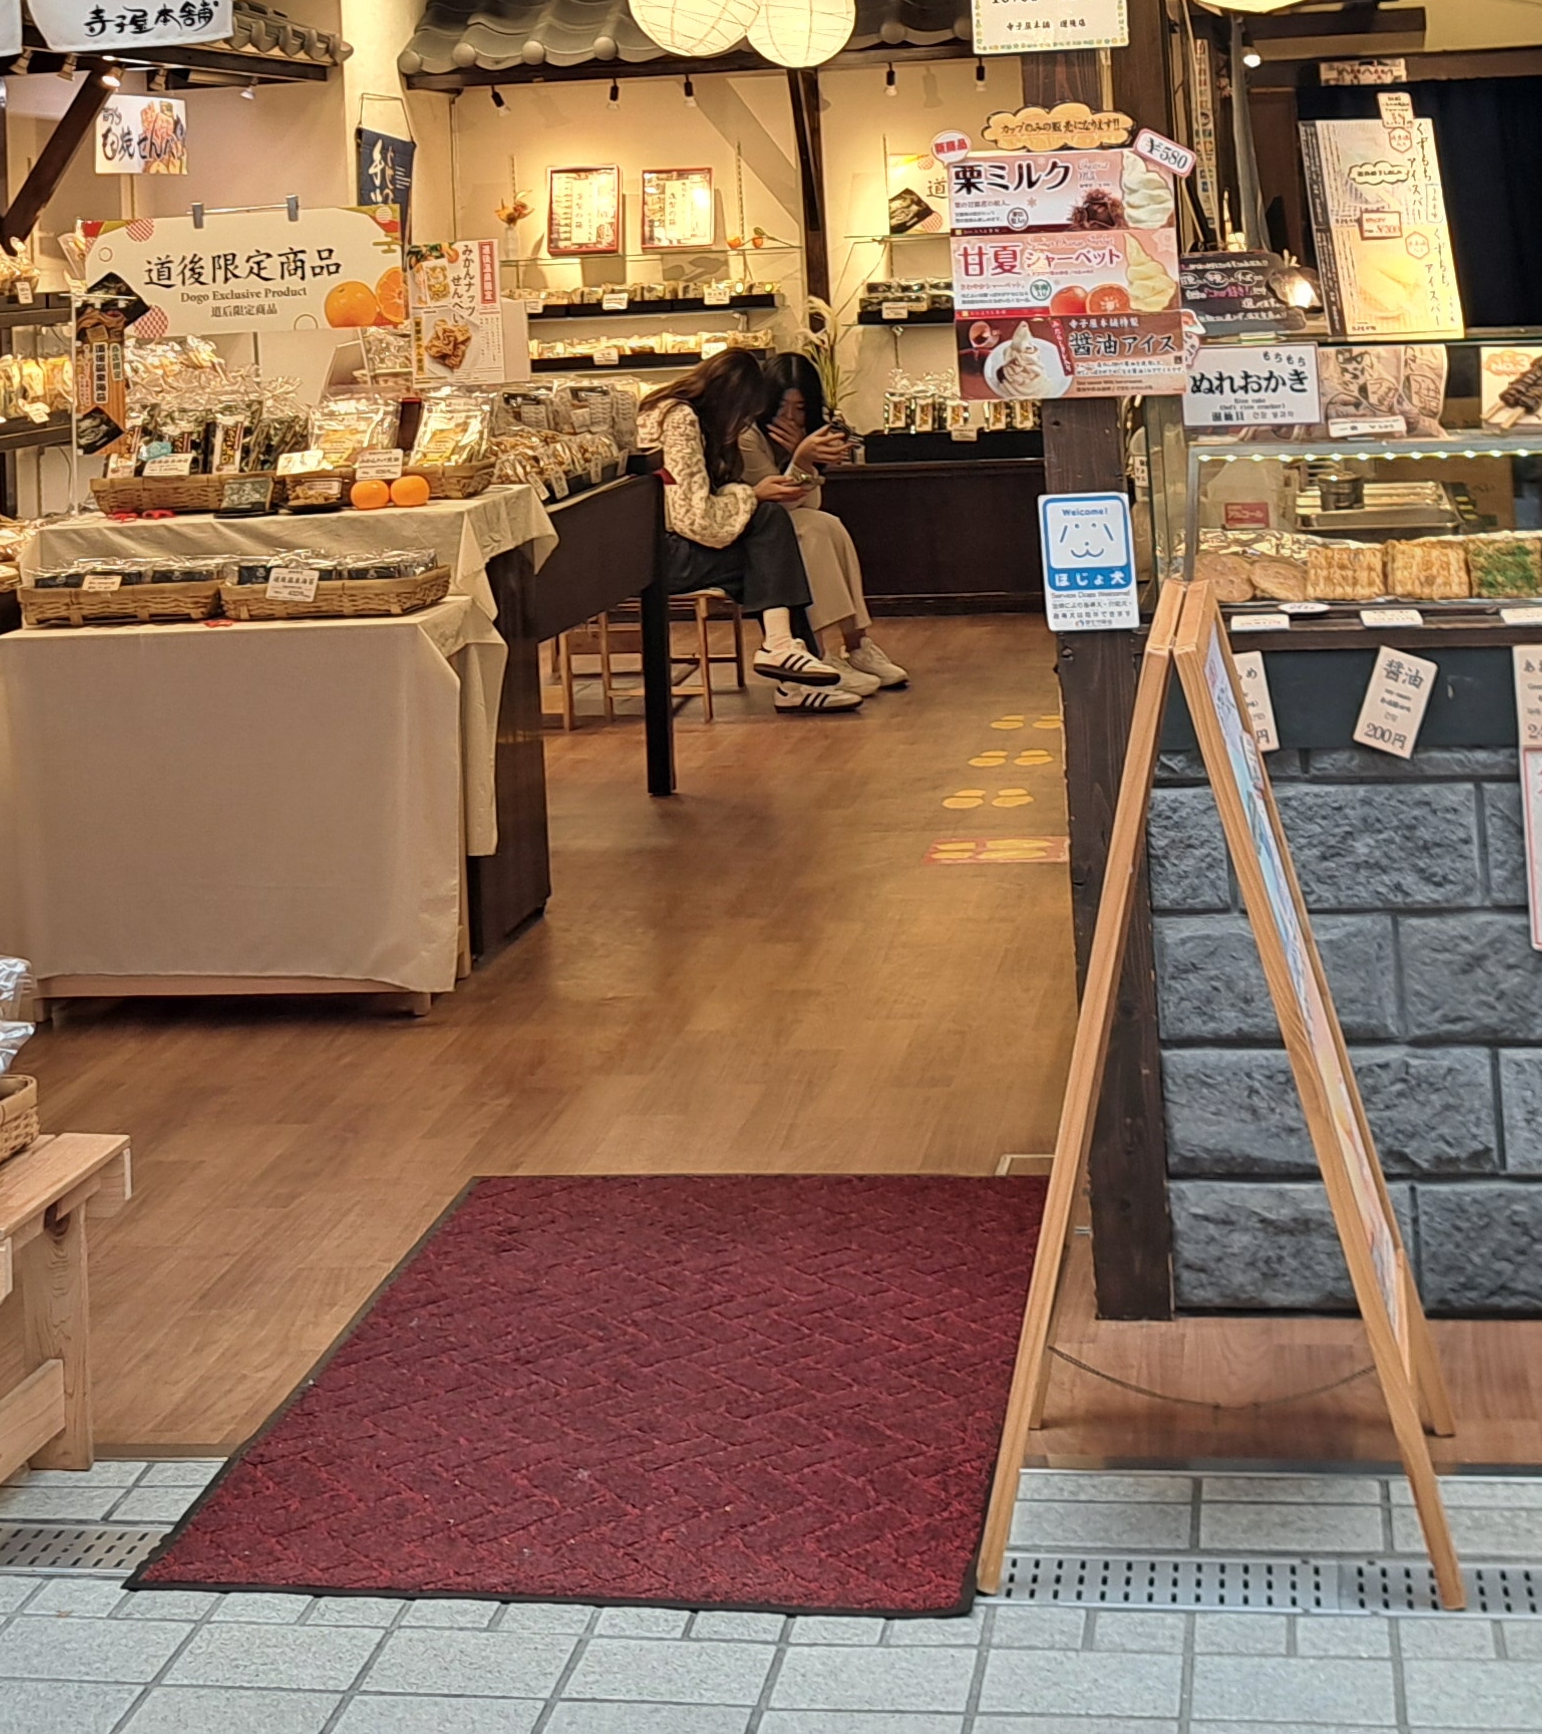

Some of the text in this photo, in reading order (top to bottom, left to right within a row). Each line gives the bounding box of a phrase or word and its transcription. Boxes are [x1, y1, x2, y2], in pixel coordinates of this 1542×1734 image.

[1146, 137, 1188, 169] ¥580
[953, 161, 1071, 195] 栗ミルク
[143, 247, 342, 290] 道後限定商品
[958, 246, 1121, 277] 甘夏 シャーベット
[180, 286, 307, 304] Dogo Exclusive Product
[461, 245, 476, 317] みかんナッツ
[450, 275, 465, 324] せんべい
[1068, 332, 1177, 356] 醤油アイス
[1263, 351, 1306, 366] もちもち
[1190, 369, 1309, 395] ぬれおかき
[1062, 508, 1108, 516] Welcome!
[1055, 570, 1126, 587] ほじょ犬
[1383, 658, 1424, 689] 醤油
[1364, 722, 1407, 751] 200円
